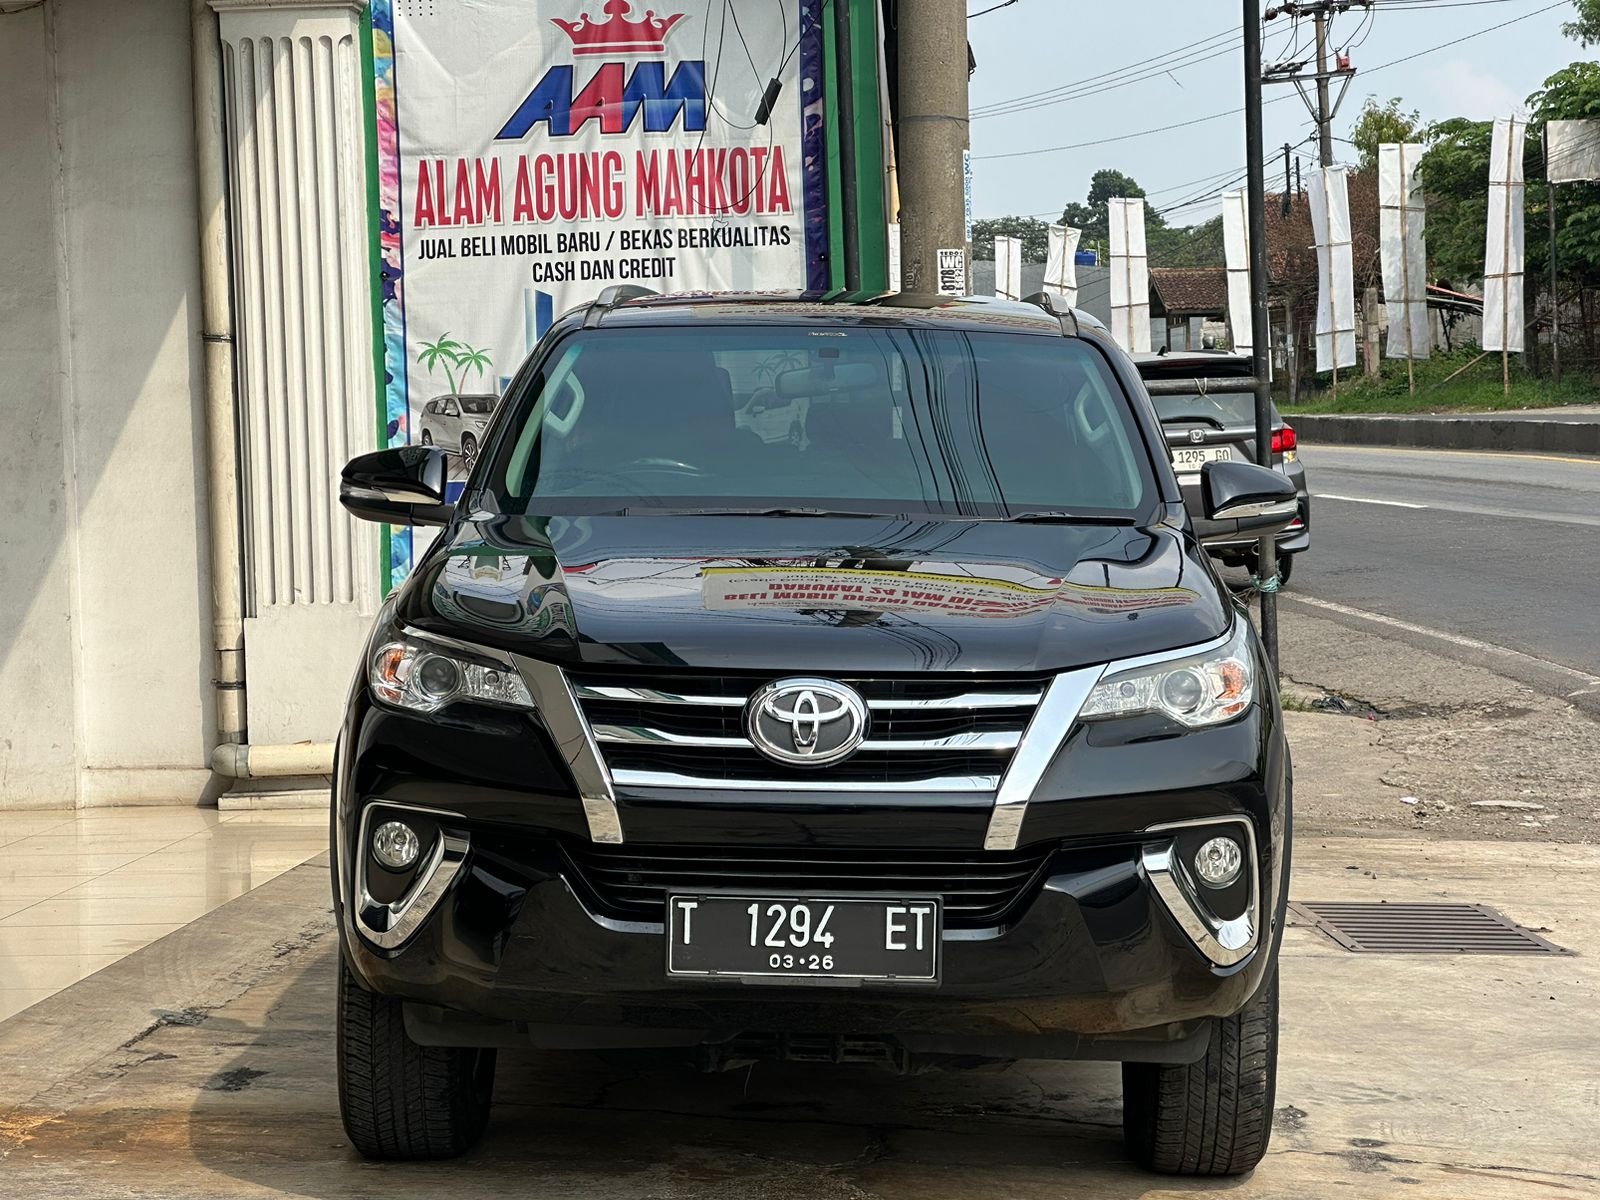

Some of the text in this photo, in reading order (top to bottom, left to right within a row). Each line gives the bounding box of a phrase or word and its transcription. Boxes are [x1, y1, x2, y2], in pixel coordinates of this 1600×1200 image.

[494, 61, 706, 140] AAM
[414, 145, 791, 227] ALAM AGUNG MAHKOTA
[418, 225, 790, 260] JUAL BELI MOBIL BARU / BEKAS BERKUALITAS
[532, 257, 676, 282] CASH DAN CREDIT
[940, 256, 963, 268] WC
[941, 270, 955, 290] 8178
[1178, 450, 1205, 463] 1295
[678, 902, 930, 951] T 1294 ET
